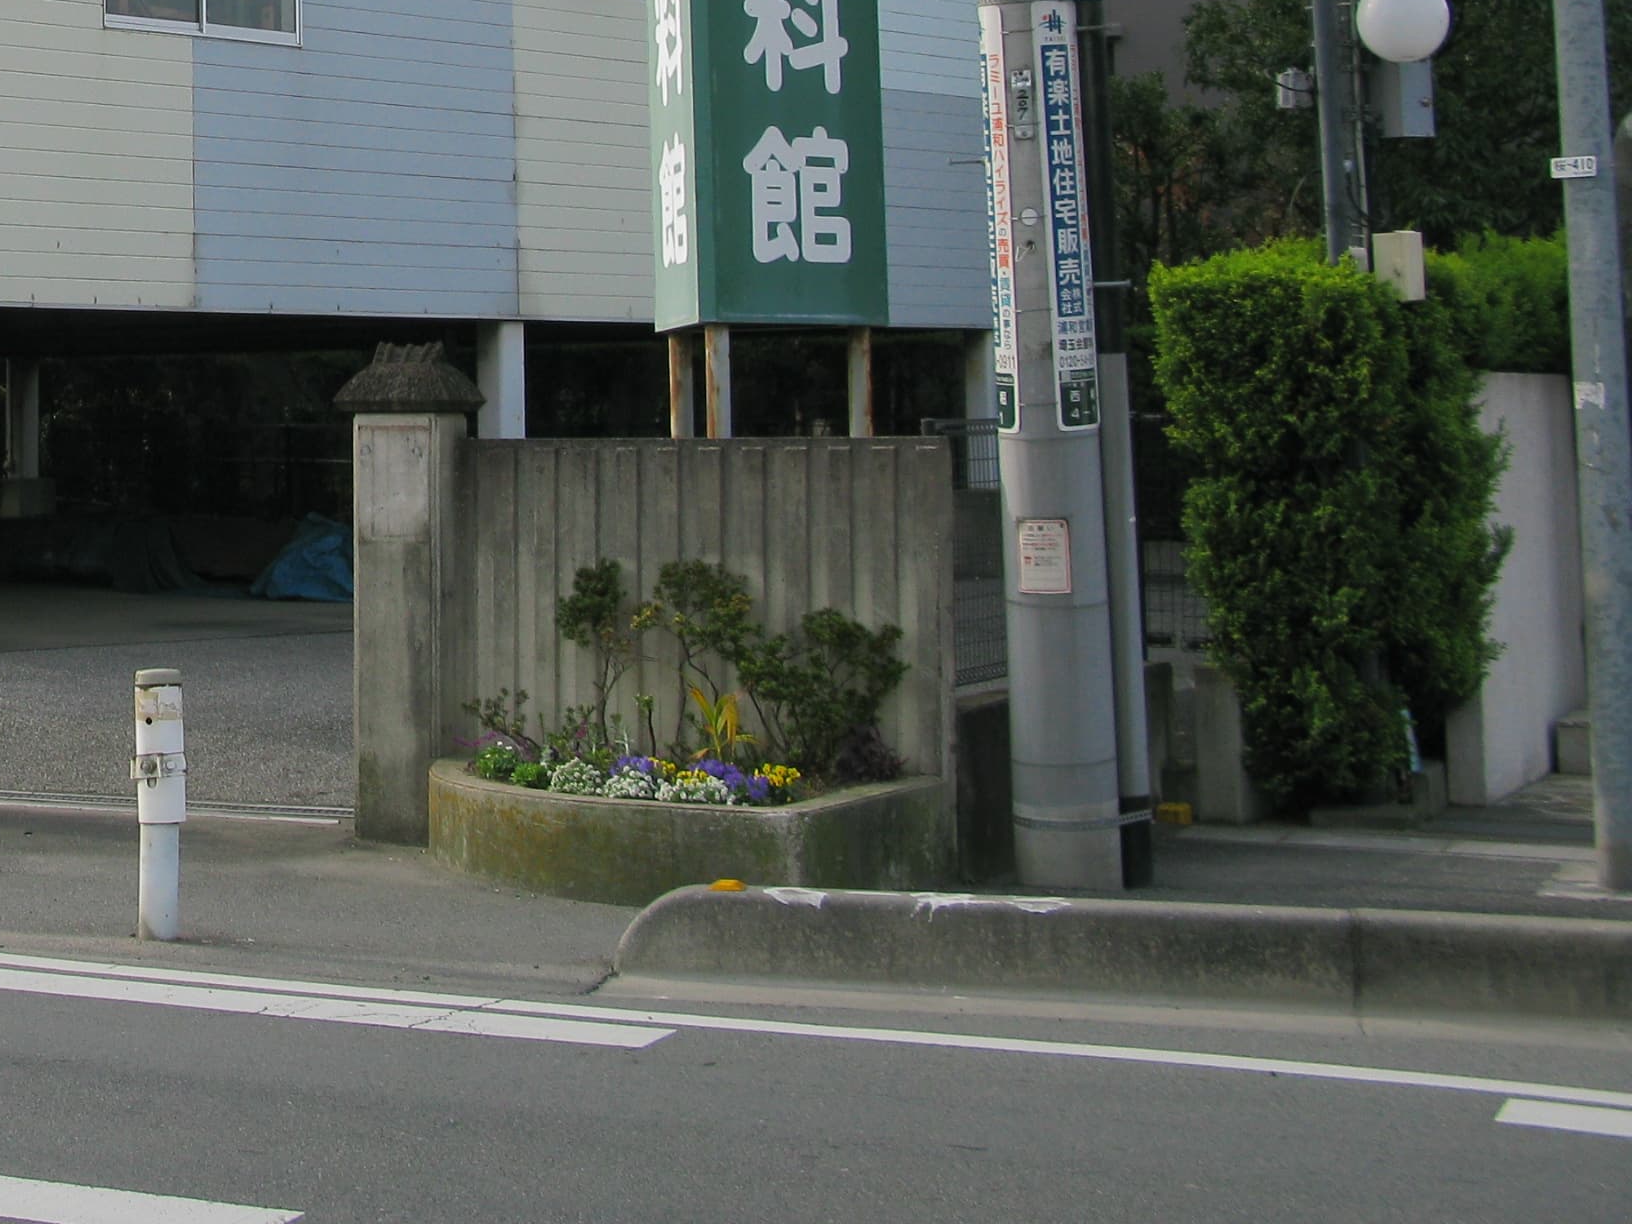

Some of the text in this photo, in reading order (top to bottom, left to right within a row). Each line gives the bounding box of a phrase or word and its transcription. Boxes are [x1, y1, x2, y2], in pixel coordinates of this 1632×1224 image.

[1044, 48, 1081, 285] 有楽土地住宅販売
